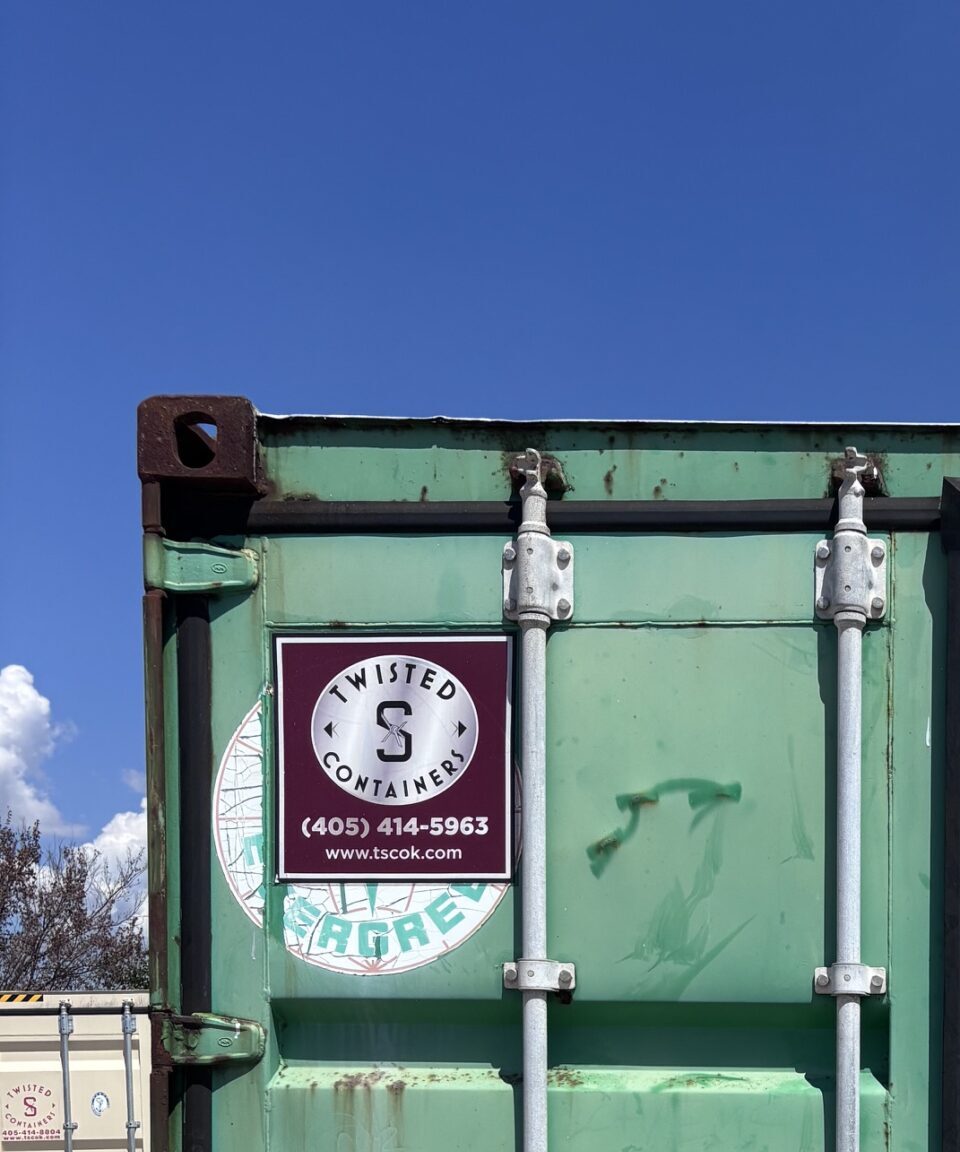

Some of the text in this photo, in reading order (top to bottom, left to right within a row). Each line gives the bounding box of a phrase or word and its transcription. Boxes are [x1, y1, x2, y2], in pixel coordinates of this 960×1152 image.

[329, 662, 456, 703] TWISTED
[323, 749, 465, 799] CONTAINERS
[301, 816, 489, 838] (405) 414-5963
[325, 845, 462, 860] www.tscok.com
[7, 1084, 52, 1098] TWISTED
[5, 1111, 56, 1128] CONTAINERS
